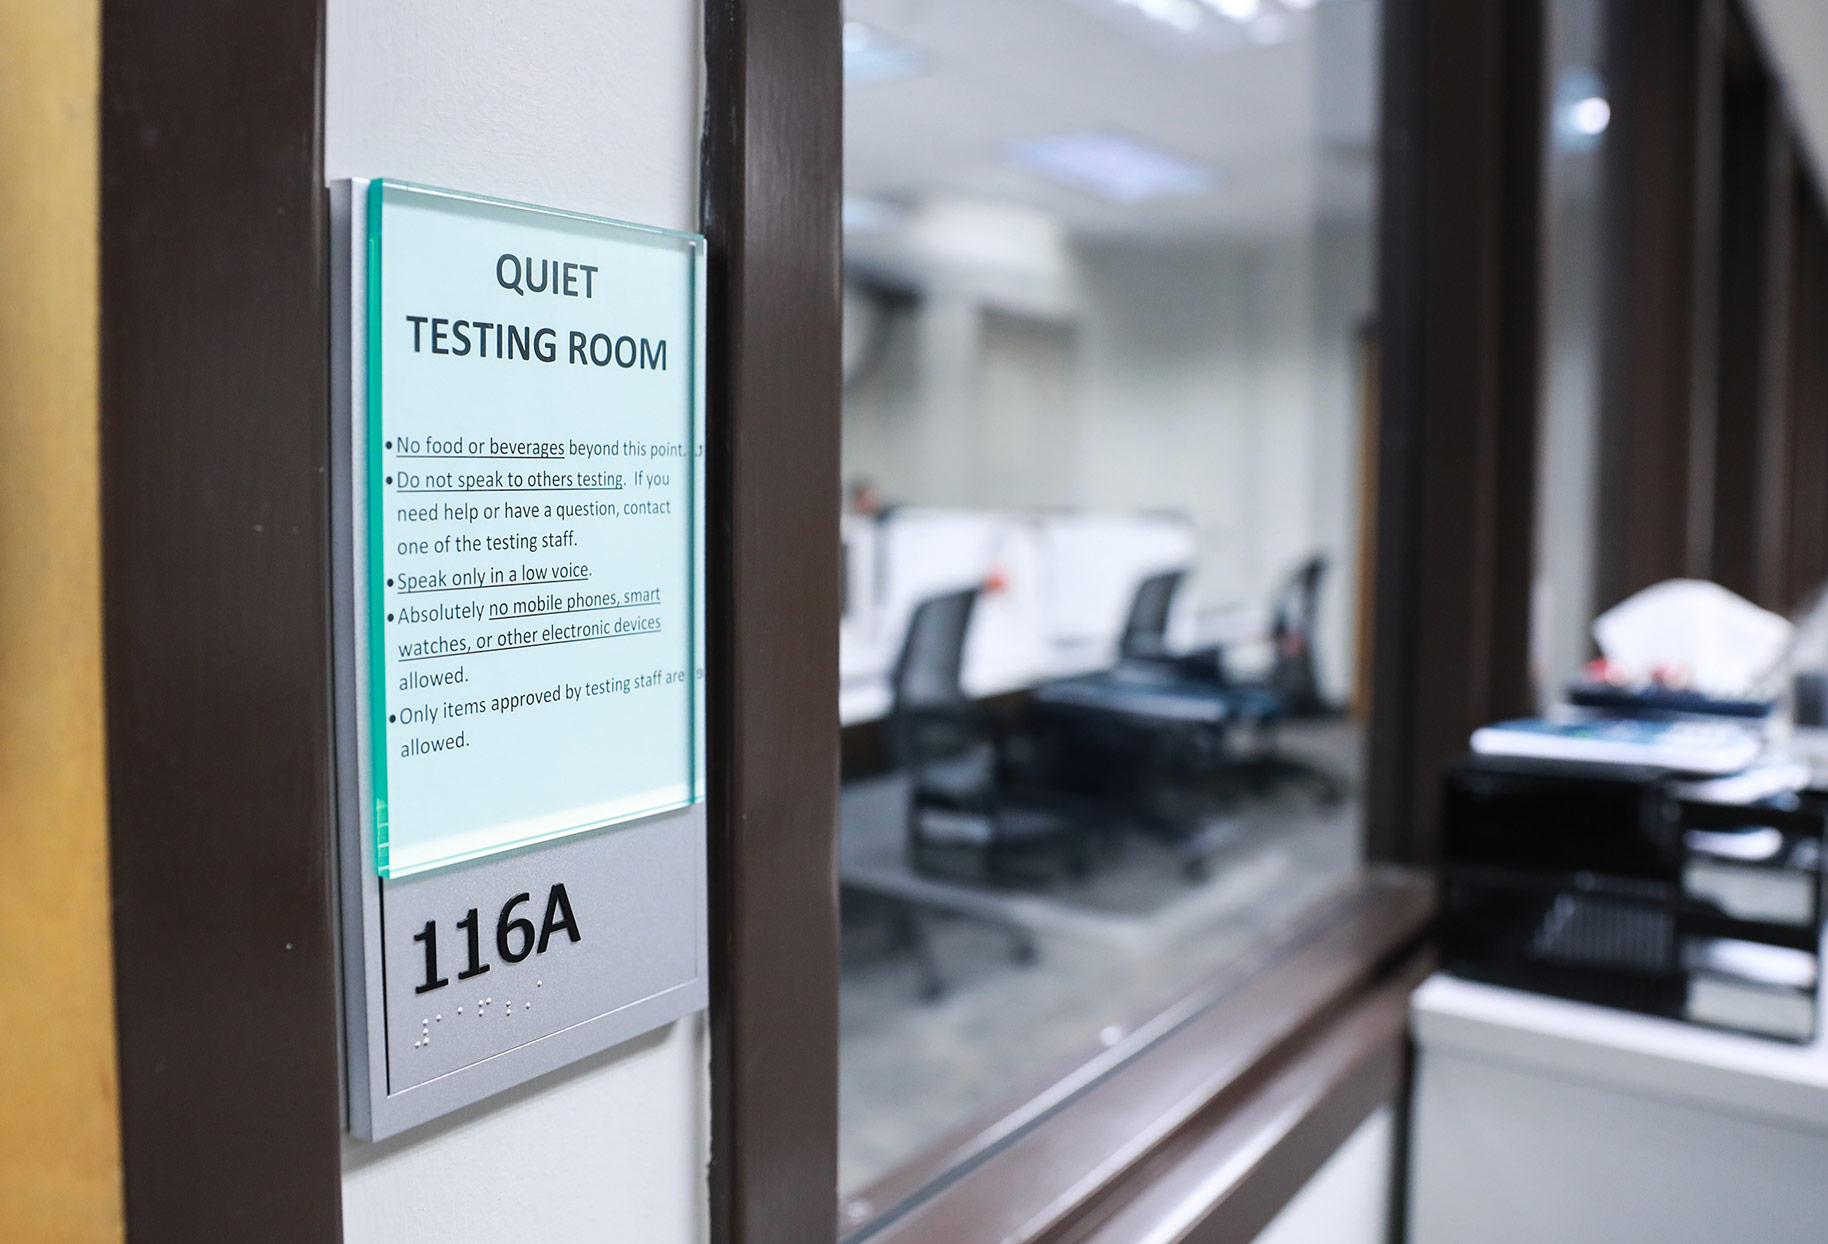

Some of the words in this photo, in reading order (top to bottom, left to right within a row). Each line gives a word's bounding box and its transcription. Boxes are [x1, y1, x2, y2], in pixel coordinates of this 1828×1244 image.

[496, 254, 598, 298] QUIET
[406, 315, 556, 362] TESTING
[569, 331, 666, 370] ROOM
[397, 437, 420, 453] No
[426, 436, 463, 454] food
[469, 441, 485, 454] or
[491, 437, 564, 458] beverages
[569, 439, 619, 458] beyond
[623, 440, 646, 456] this
[651, 442, 687, 459] point.
[398, 471, 420, 488] Do
[426, 473, 452, 487] not
[458, 470, 503, 491] speak
[508, 472, 523, 487] to
[528, 470, 572, 487] others
[577, 471, 626, 489] testing.
[635, 470, 643, 486] If
[647, 474, 669, 489] you
[398, 504, 438, 521] need
[445, 503, 478, 523] help
[484, 506, 500, 519] or
[505, 502, 539, 518] have
[544, 505, 551, 517] a
[556, 501, 619, 520] question,
[624, 500, 671, 515] contact
[398, 541, 428, 555] one
[434, 535, 451, 553] of
[455, 535, 481, 552] the
[487, 534, 537, 552] testing
[542, 530, 577, 548] staff.
[398, 570, 446, 592] Speak
[452, 568, 485, 587] only
[491, 567, 503, 583] in
[509, 570, 517, 582] a
[522, 565, 548, 580] low
[552, 562, 592, 578] voice.
[398, 601, 484, 624] Absolutely
[489, 602, 508, 616] no
[514, 594, 562, 614] mobile
[567, 592, 620, 612] phones,
[624, 587, 660, 603] smart
[398, 636, 471, 657] watches,
[477, 635, 493, 648] or
[498, 628, 538, 646] other
[542, 620, 610, 641] electronic
[614, 616, 661, 633] devices
[399, 666, 468, 691] allowed.
[400, 705, 438, 724] Only
[443, 700, 486, 718] items
[491, 685, 561, 713] approved
[566, 684, 581, 701] by
[585, 678, 630, 696] testing
[634, 670, 662, 688] staff
[666, 670, 685, 684] are
[401, 730, 469, 757] allowed.
[414, 883, 581, 994] 116A
